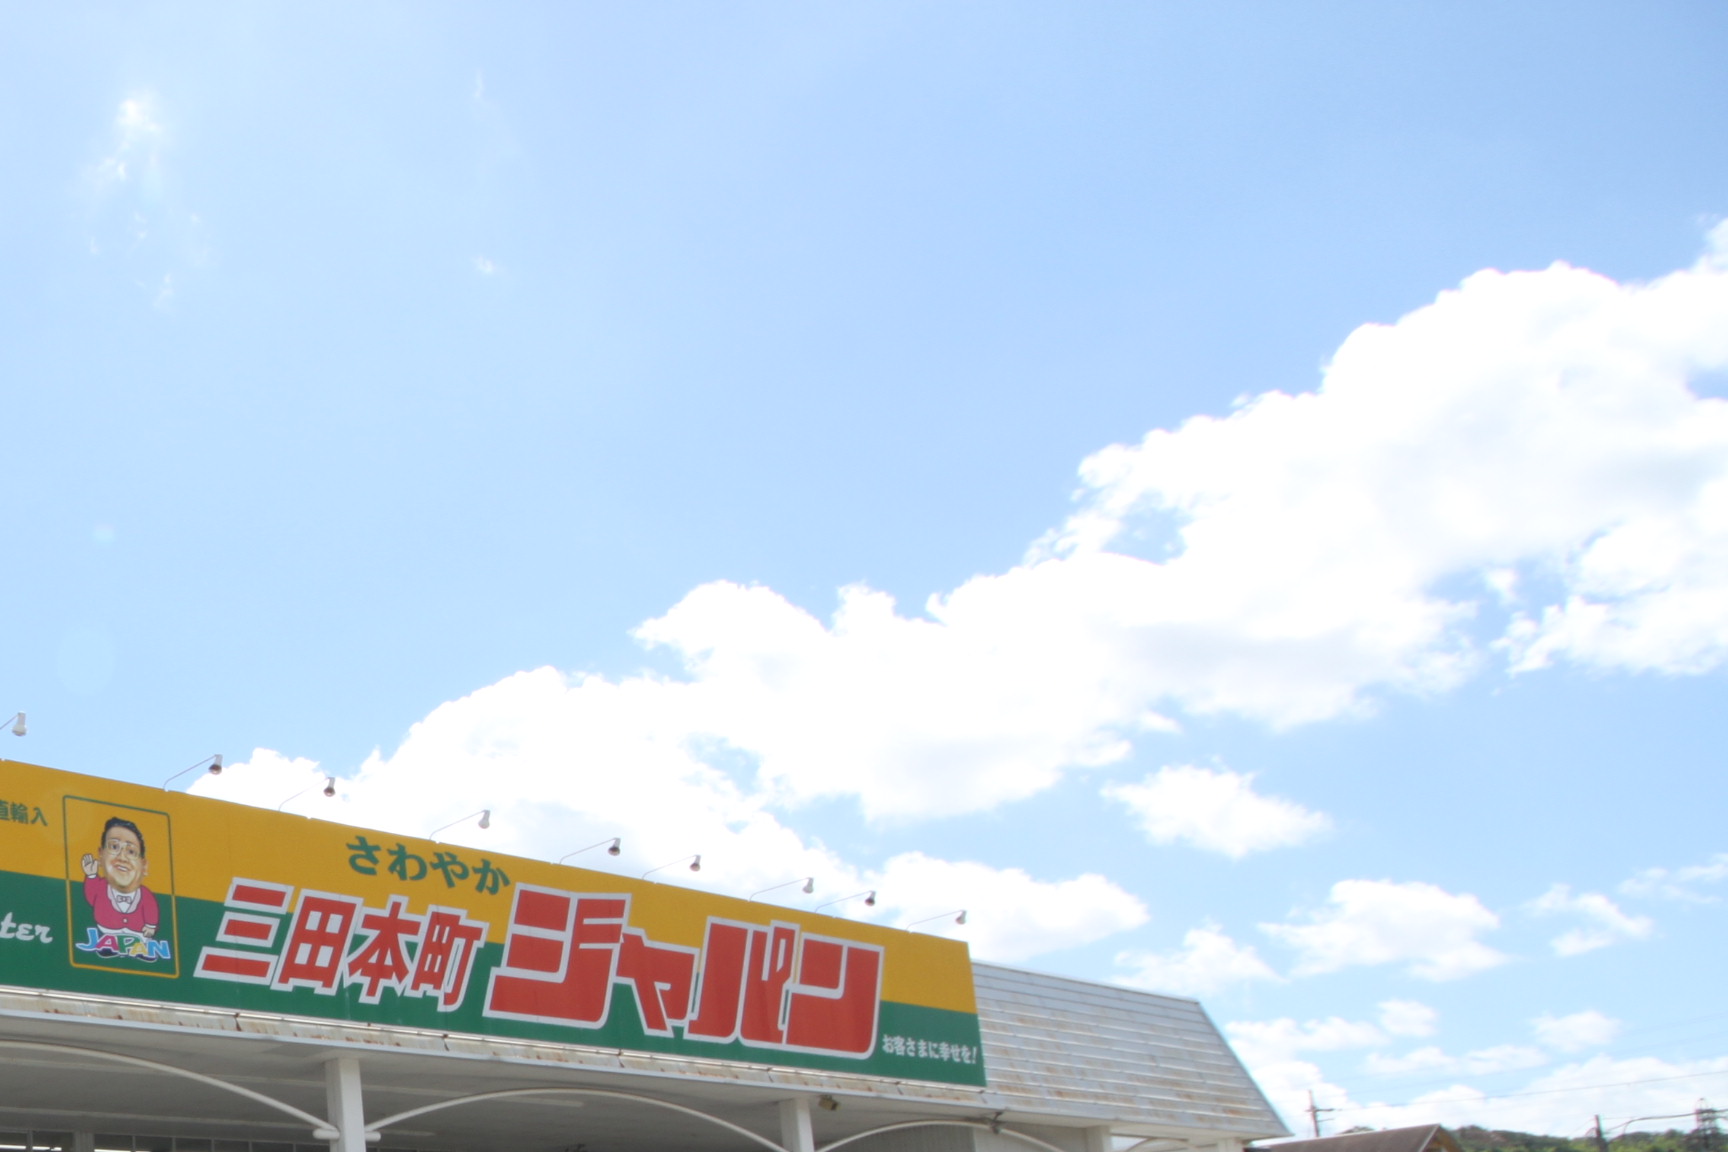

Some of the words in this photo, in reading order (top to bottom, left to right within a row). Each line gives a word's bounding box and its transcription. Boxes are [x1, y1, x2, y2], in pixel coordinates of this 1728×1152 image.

[345, 836, 510, 896] さわやか
[75, 927, 171, 960] JAPAN
[193, 876, 490, 1013] 三田本町
[482, 882, 885, 1060] ジャパン
